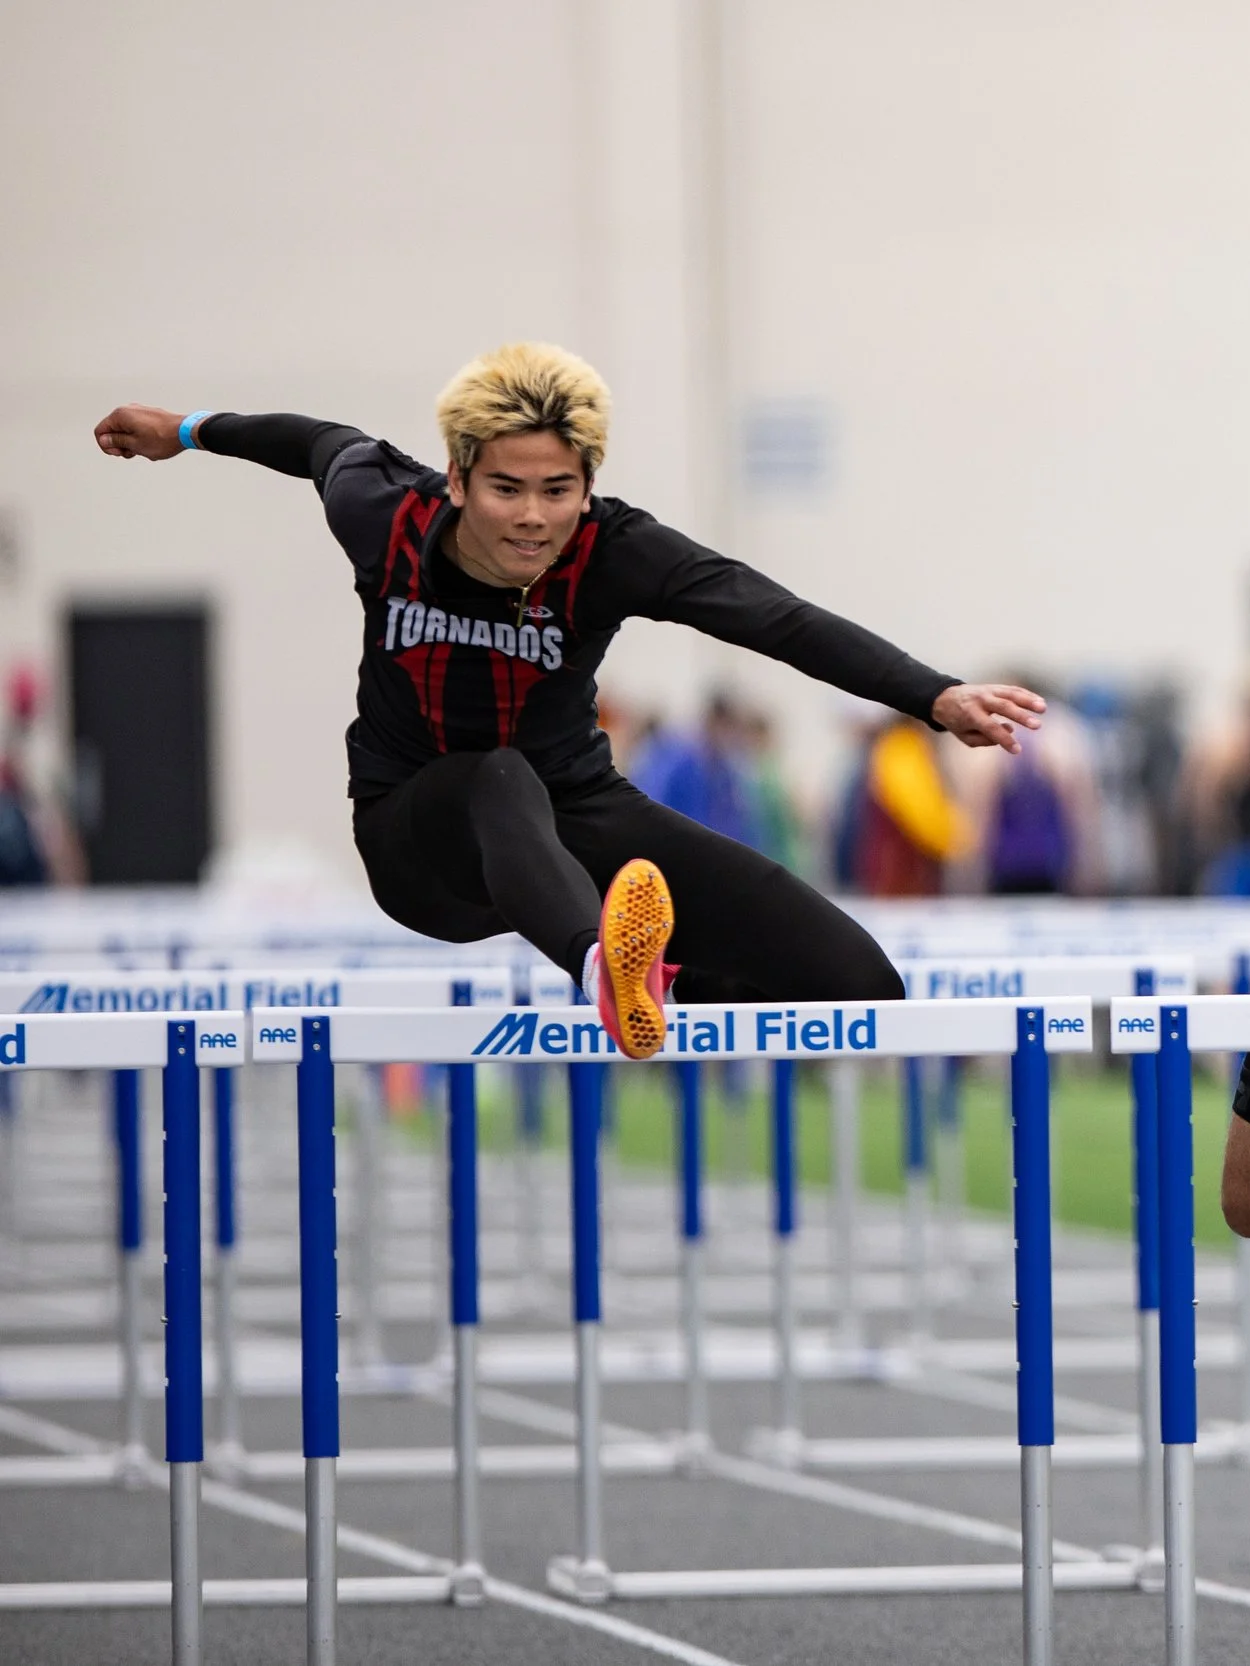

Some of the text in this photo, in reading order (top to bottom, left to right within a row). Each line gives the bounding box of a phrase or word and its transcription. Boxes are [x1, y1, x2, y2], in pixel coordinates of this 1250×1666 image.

[385, 596, 563, 670] TORNADOS
[18, 979, 341, 1013] Memorial Field
[929, 969, 1025, 998] Field
[471, 1009, 877, 1055] Memial Field
